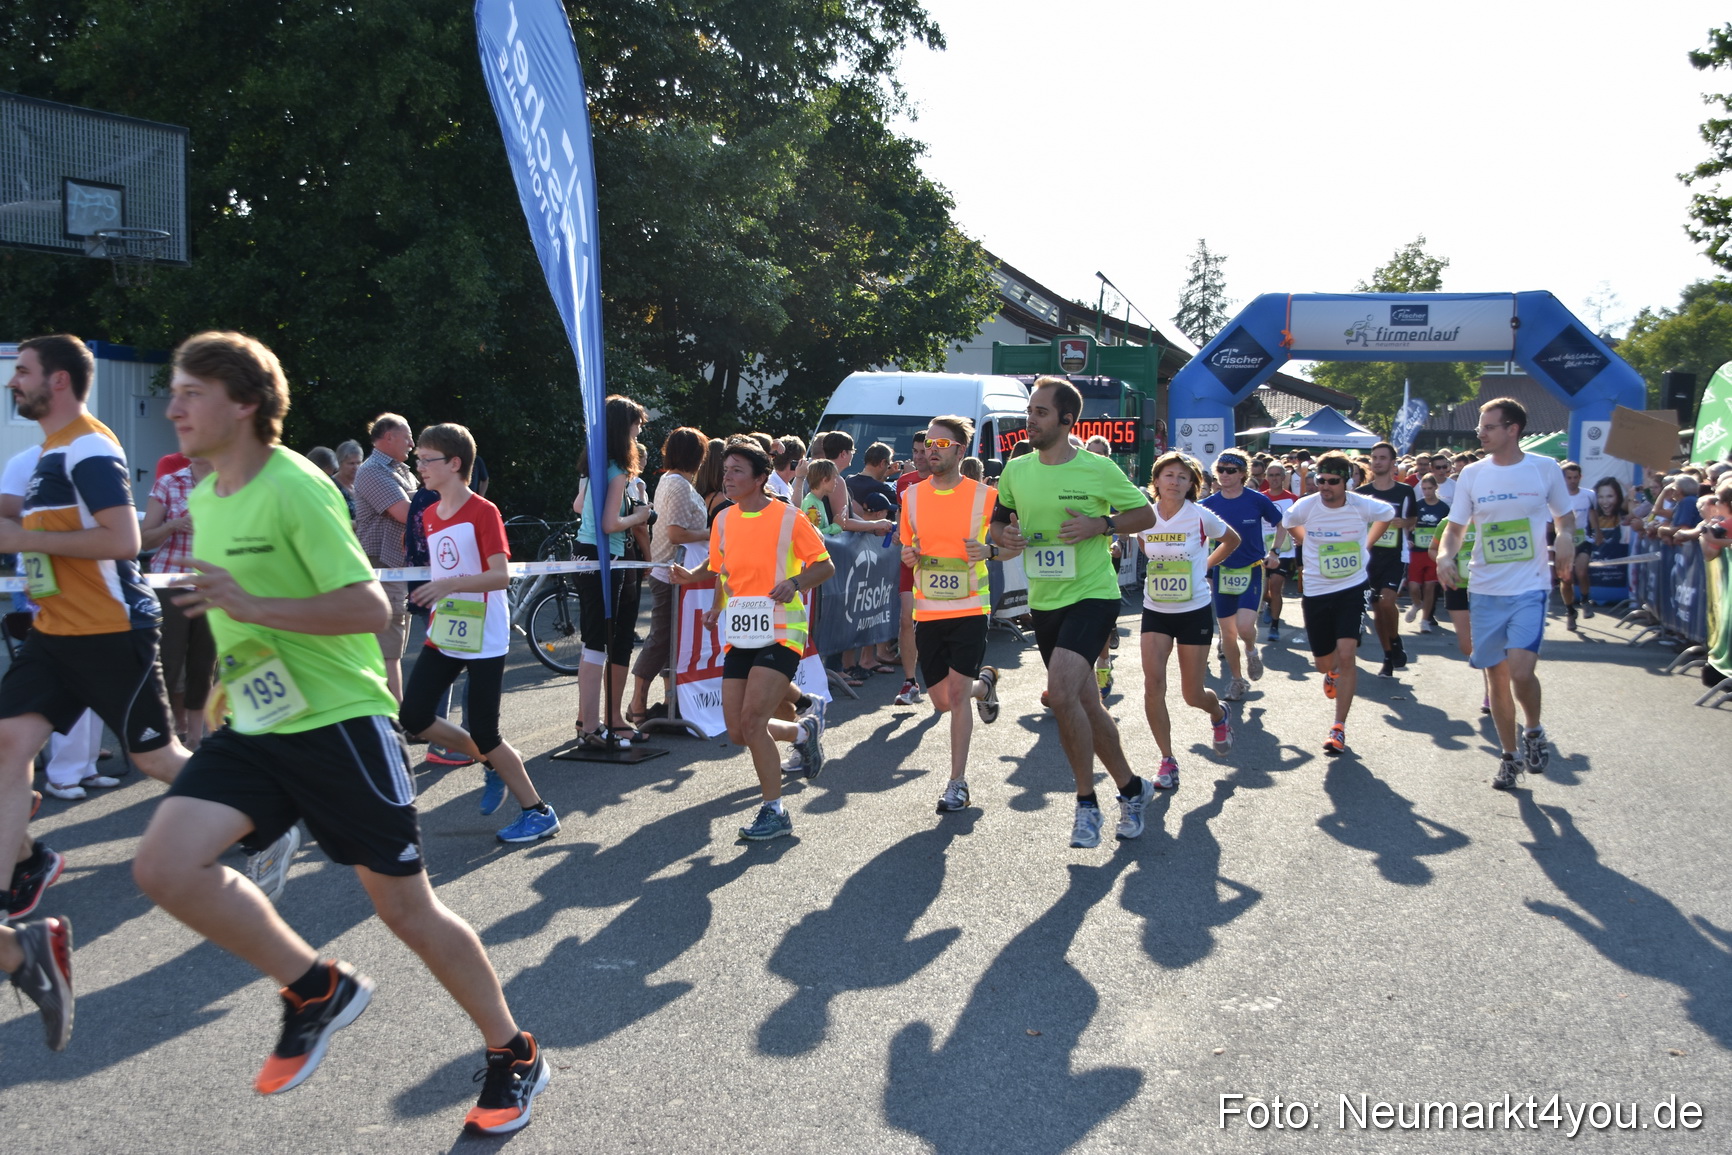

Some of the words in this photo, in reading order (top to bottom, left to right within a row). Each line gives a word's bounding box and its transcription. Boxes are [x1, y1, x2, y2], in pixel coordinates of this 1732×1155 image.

[1398, 311, 1427, 319] Fischer
[1376, 326, 1461, 341] firmenlauf
[1220, 355, 1264, 364] Fischer
[1697, 417, 1727, 450] AOK
[1147, 533, 1183, 542] ONLINE
[1487, 535, 1529, 553] 1303
[1034, 550, 1065, 567] 191
[1323, 555, 1358, 570] 1306
[929, 574, 960, 590] 288
[1151, 577, 1188, 592] 1020
[1222, 576, 1249, 588] 1492
[728, 599, 767, 608] df-sports
[447, 619, 468, 638] 78
[731, 613, 770, 632] 8916
[242, 670, 287, 711] 193
